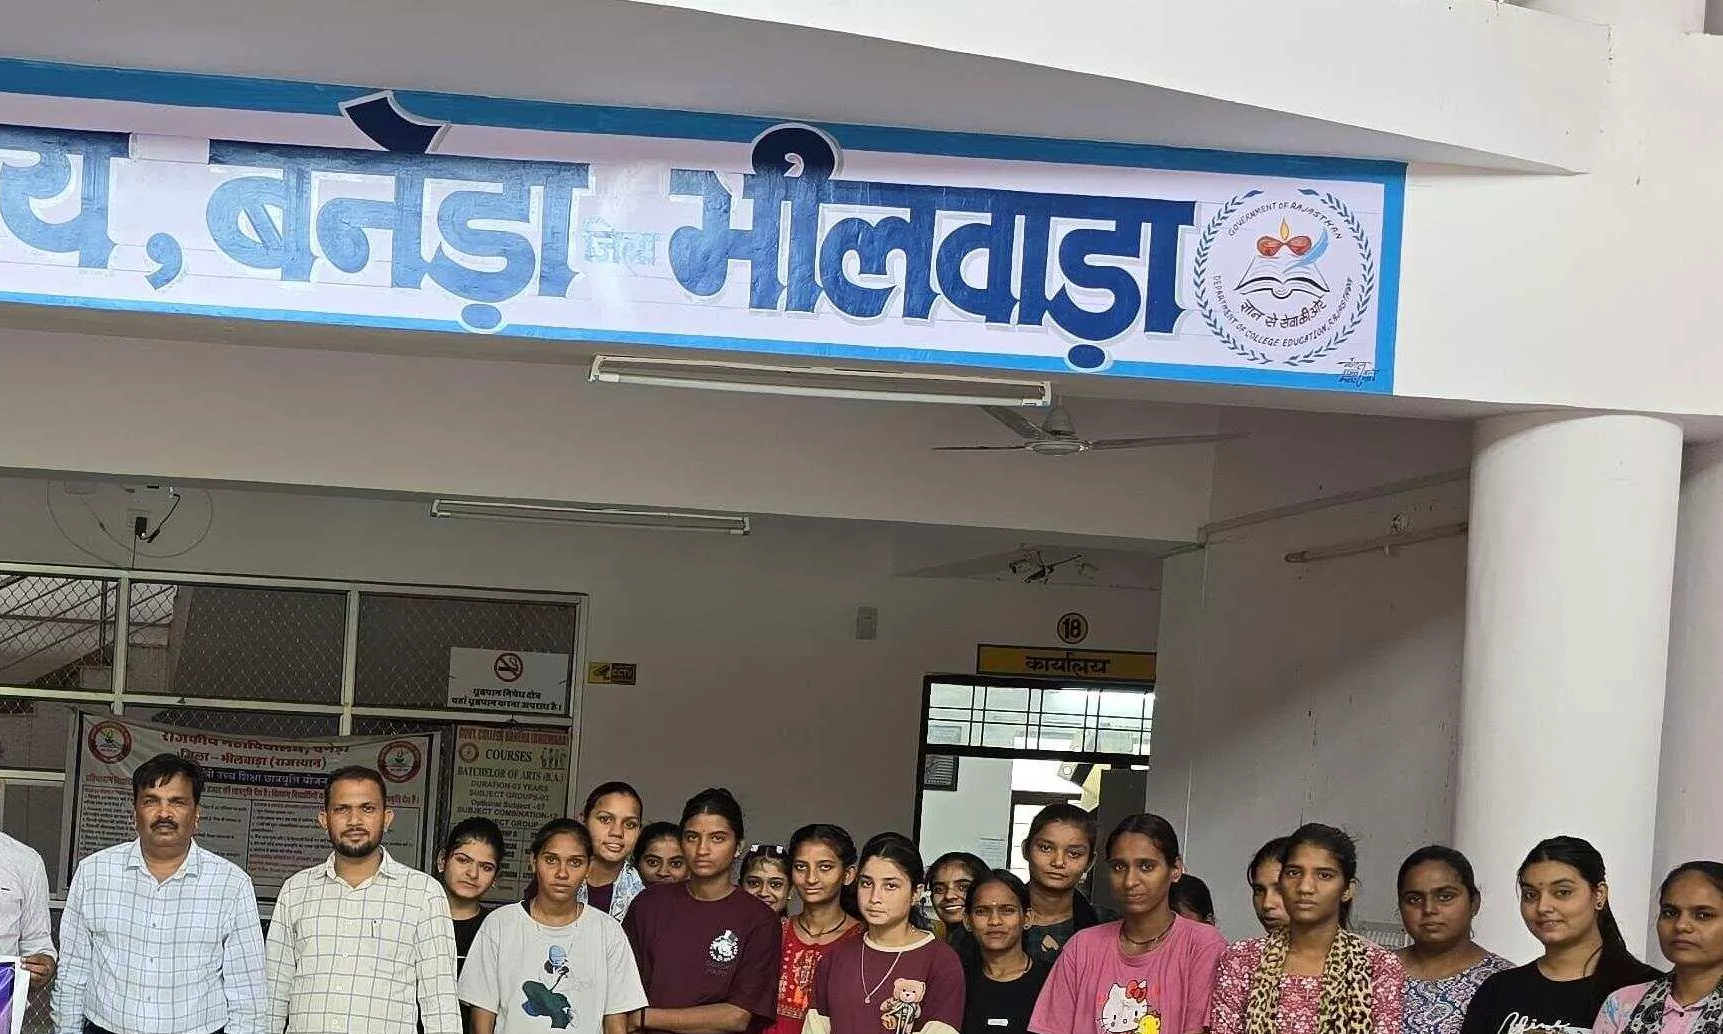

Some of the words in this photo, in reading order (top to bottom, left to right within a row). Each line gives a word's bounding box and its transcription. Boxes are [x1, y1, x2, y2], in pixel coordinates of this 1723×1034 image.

[207, 92, 589, 333] बनेड़ा
[667, 124, 1197, 370] भीलवाड़ा
[1228, 201, 1277, 237] GOVERNMENT
[1277, 201, 1289, 210] OF
[1290, 201, 1344, 241] RAJASTHAN
[1244, 328, 1280, 349] COLLEGE
[1062, 618, 1081, 640] 18
[1025, 652, 1112, 678] कार्यालय
[485, 748, 533, 762] COURSES
